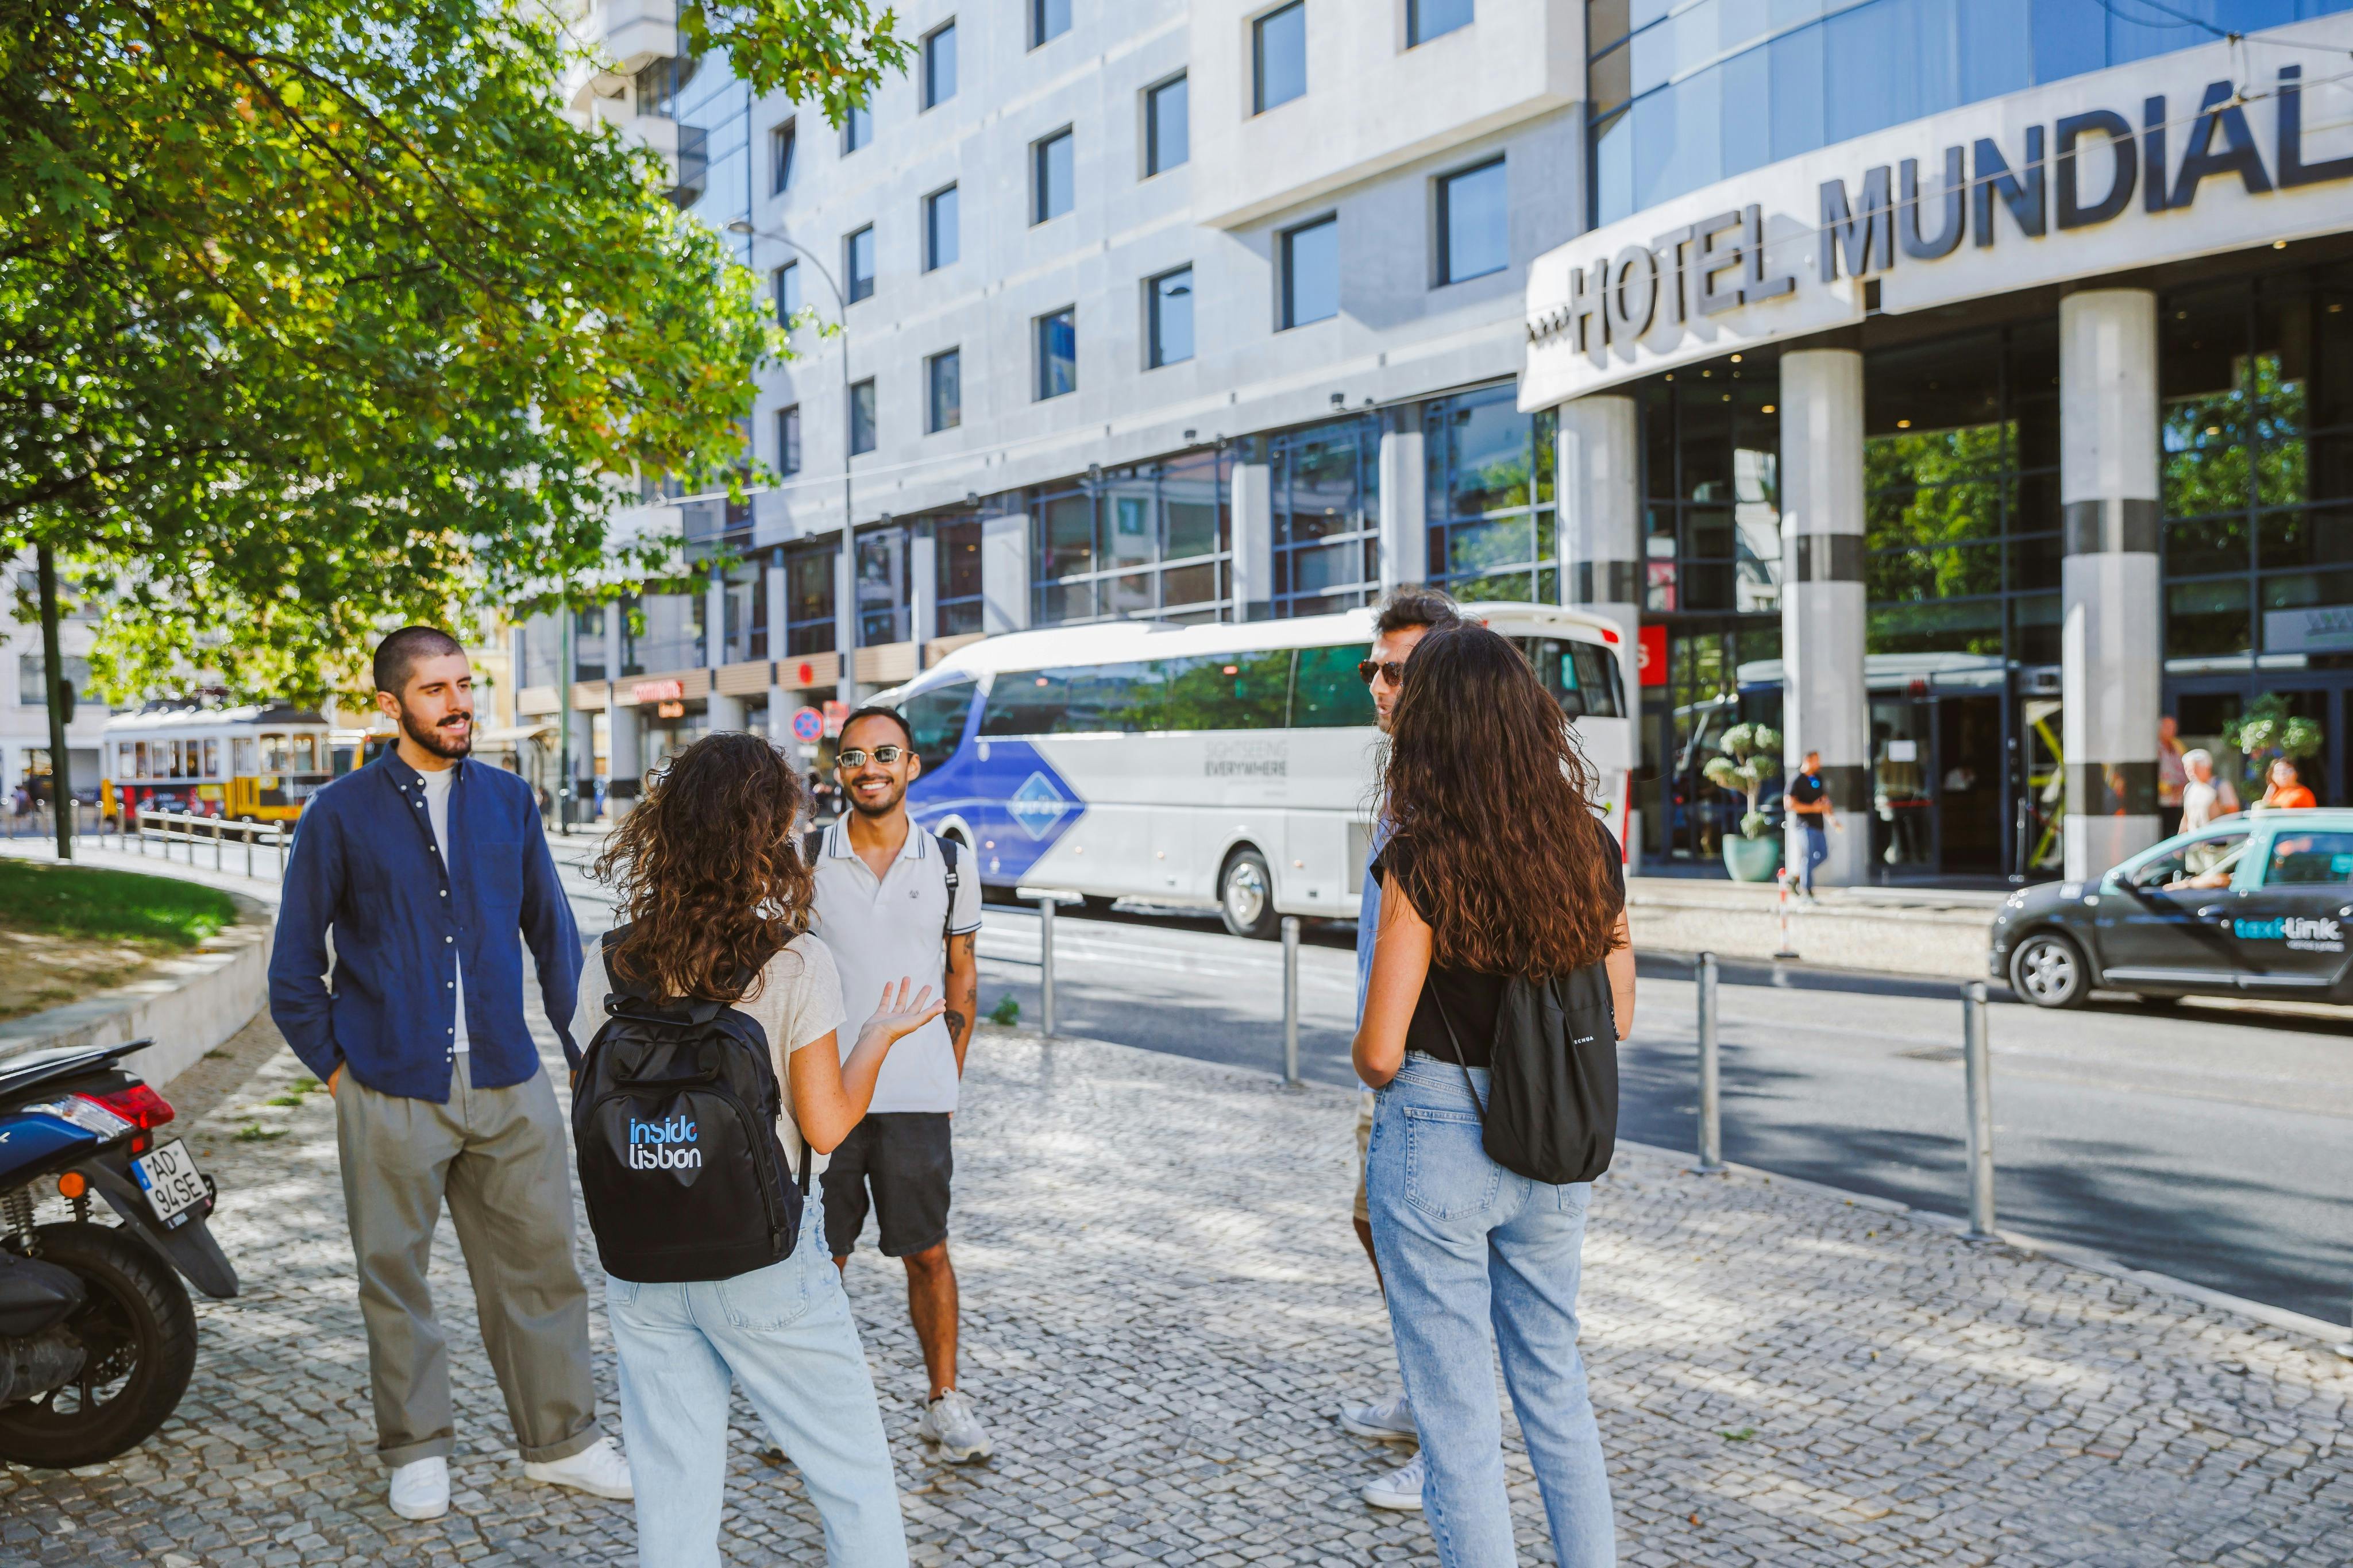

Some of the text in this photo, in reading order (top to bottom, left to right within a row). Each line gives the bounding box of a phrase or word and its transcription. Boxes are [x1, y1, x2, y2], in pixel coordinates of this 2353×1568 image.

[1569, 64, 2353, 354] HOTEL MUNDIAL
[1205, 760, 1287, 777] EVERYWHERE
[1574, 1036, 1594, 1045] ECHUA
[630, 1115, 697, 1144] inside
[151, 1150, 176, 1181] AD
[155, 1172, 202, 1213] 94SE
